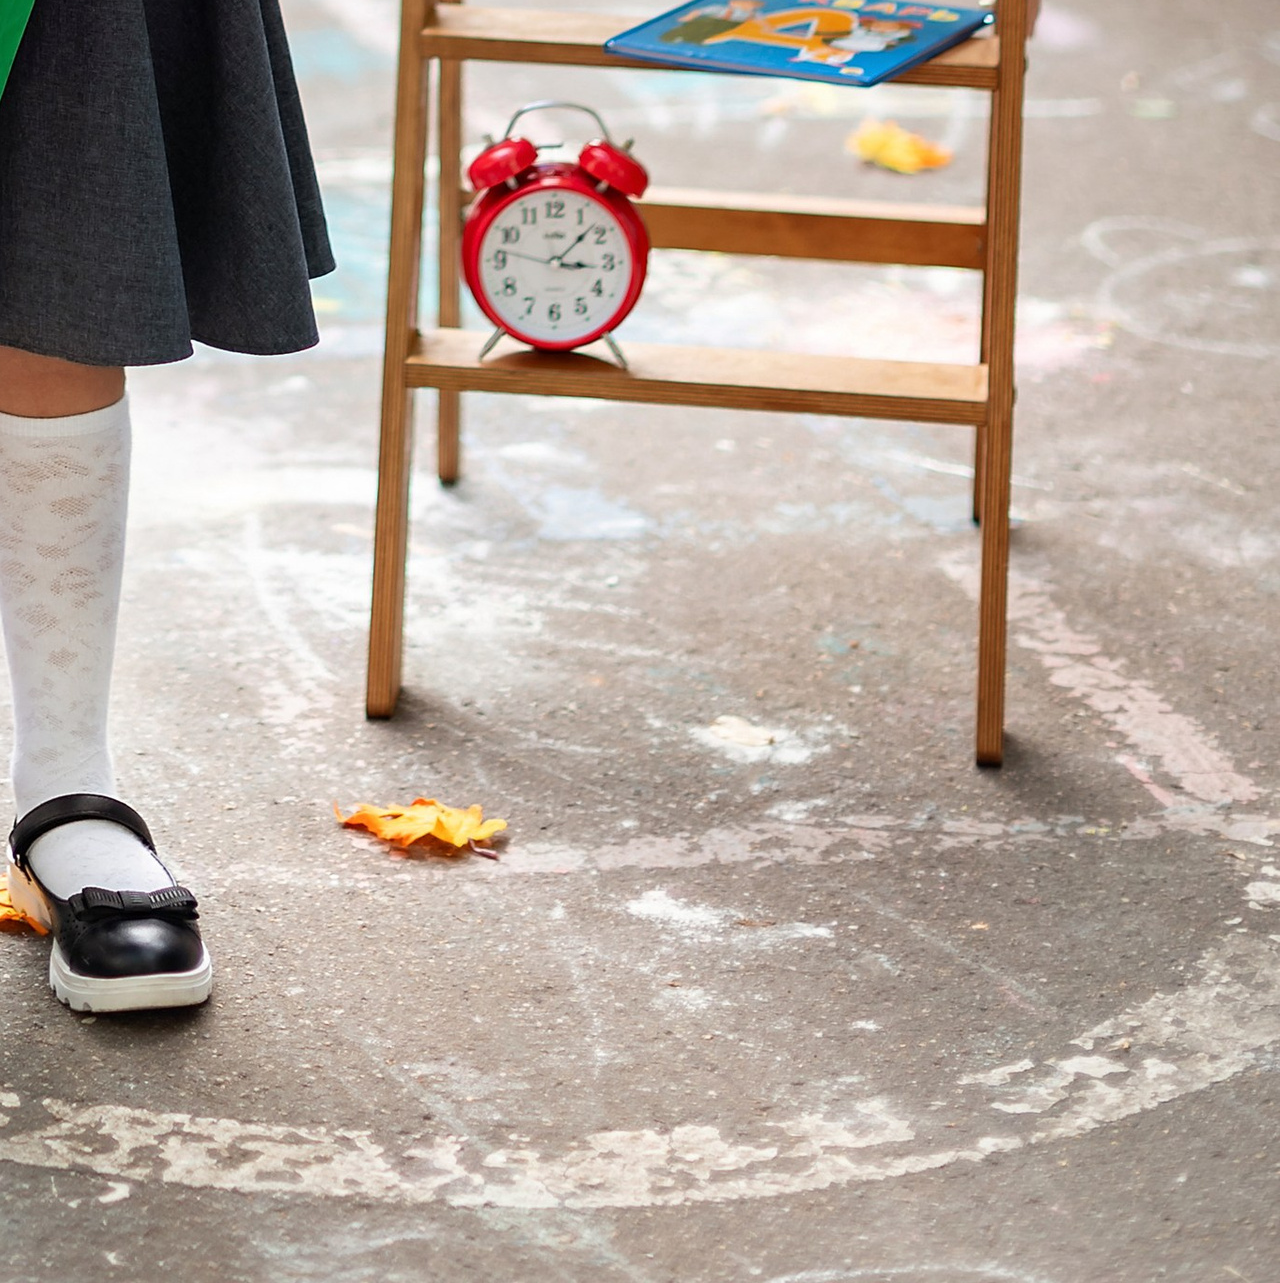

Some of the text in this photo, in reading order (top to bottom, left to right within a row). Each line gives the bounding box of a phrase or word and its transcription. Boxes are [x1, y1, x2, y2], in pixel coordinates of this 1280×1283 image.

[521, 206, 538, 225] 11
[544, 200, 566, 219] 12
[576, 207, 584, 225] 1
[500, 226, 521, 244] 10
[594, 226, 607, 245] 2
[493, 250, 507, 271] 9
[602, 253, 616, 272] 3
[502, 277, 517, 297] 8
[591, 278, 603, 297] 4
[523, 297, 536, 315] 7
[548, 303, 562, 322] 6
[574, 297, 588, 316] 5
